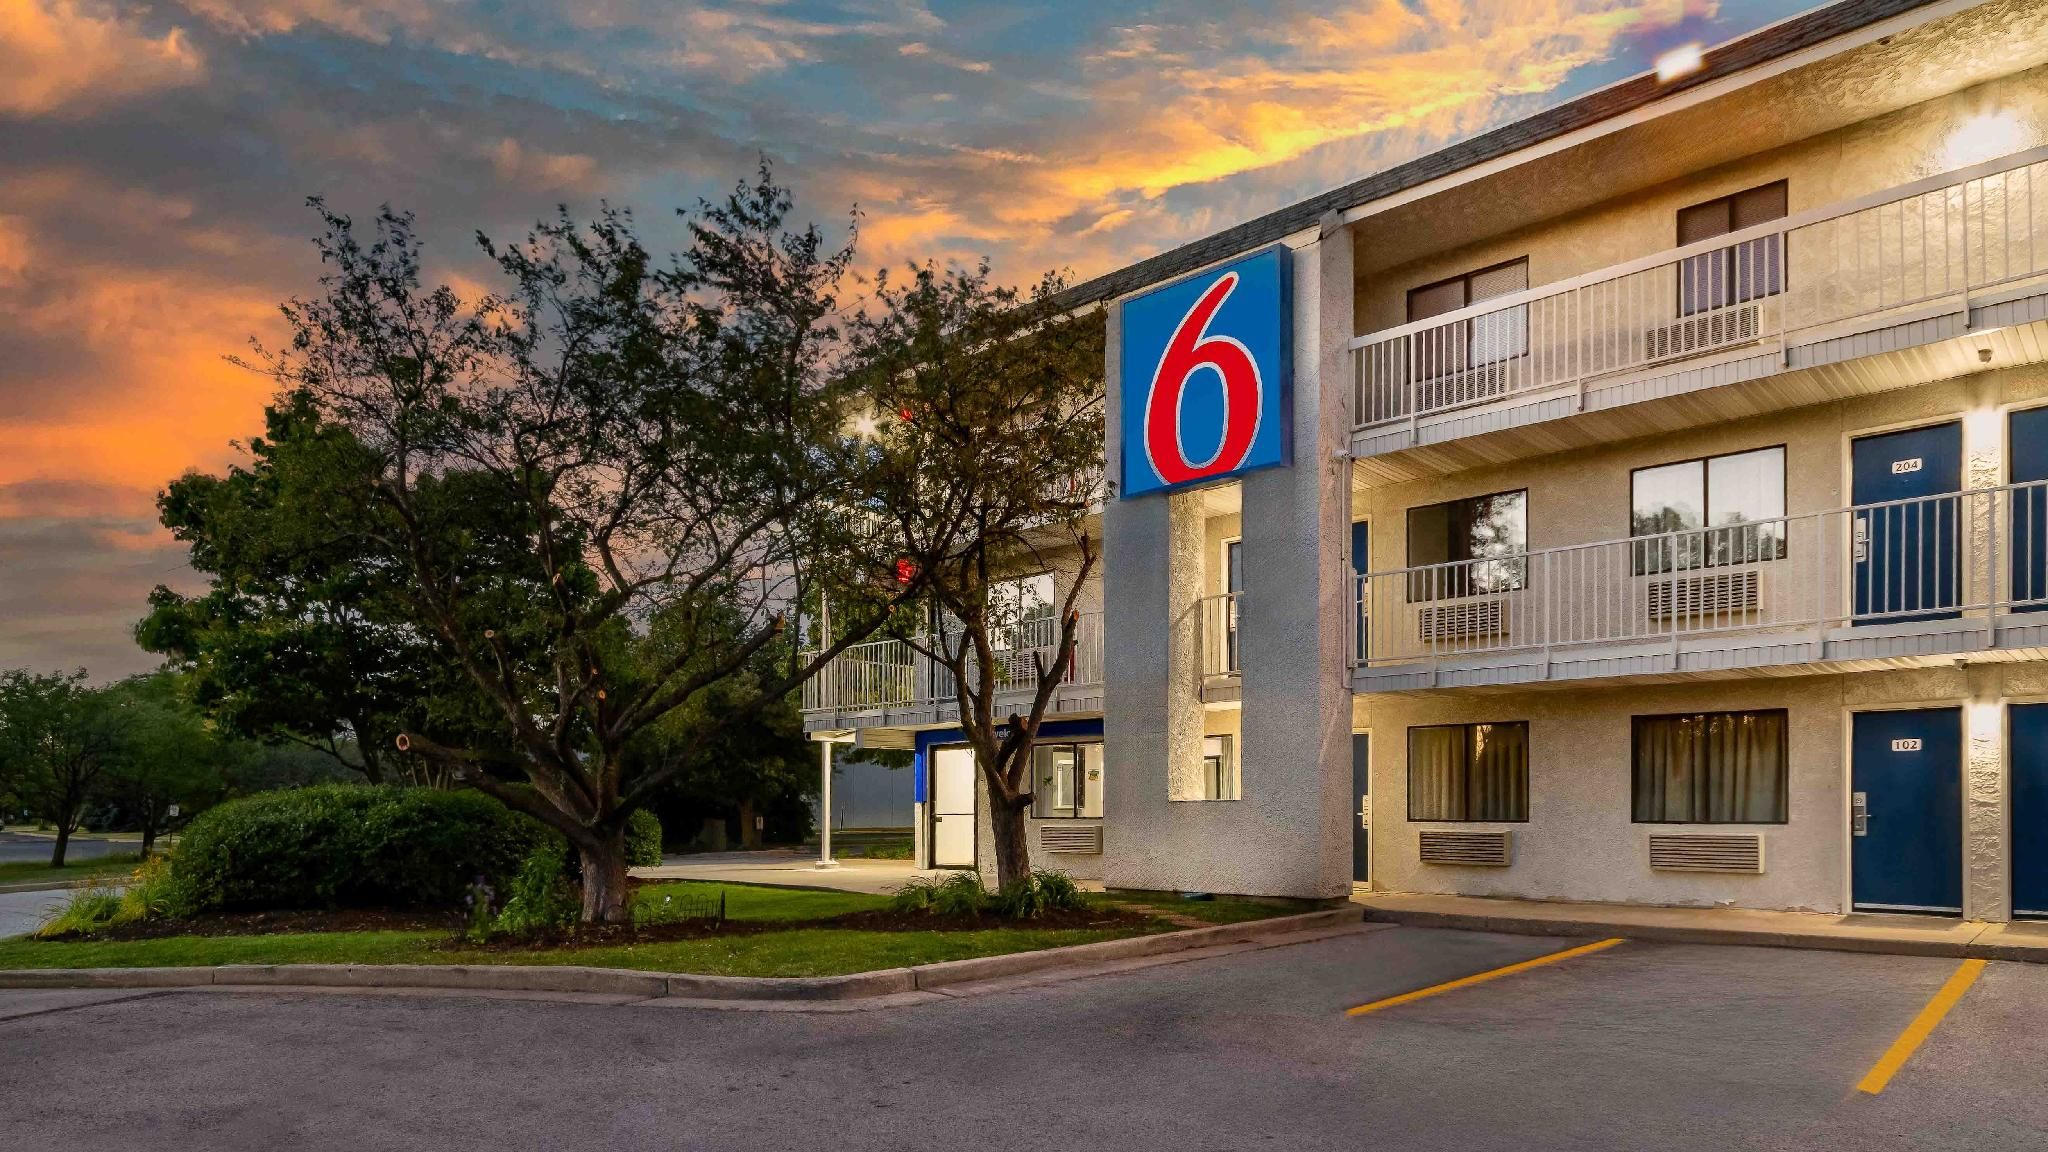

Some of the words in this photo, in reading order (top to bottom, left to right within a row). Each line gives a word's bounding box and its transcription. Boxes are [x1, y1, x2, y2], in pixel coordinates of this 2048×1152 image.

[1143, 271, 1263, 485] 6
[1896, 461, 1918, 471] 204
[1896, 741, 1918, 749] 102
